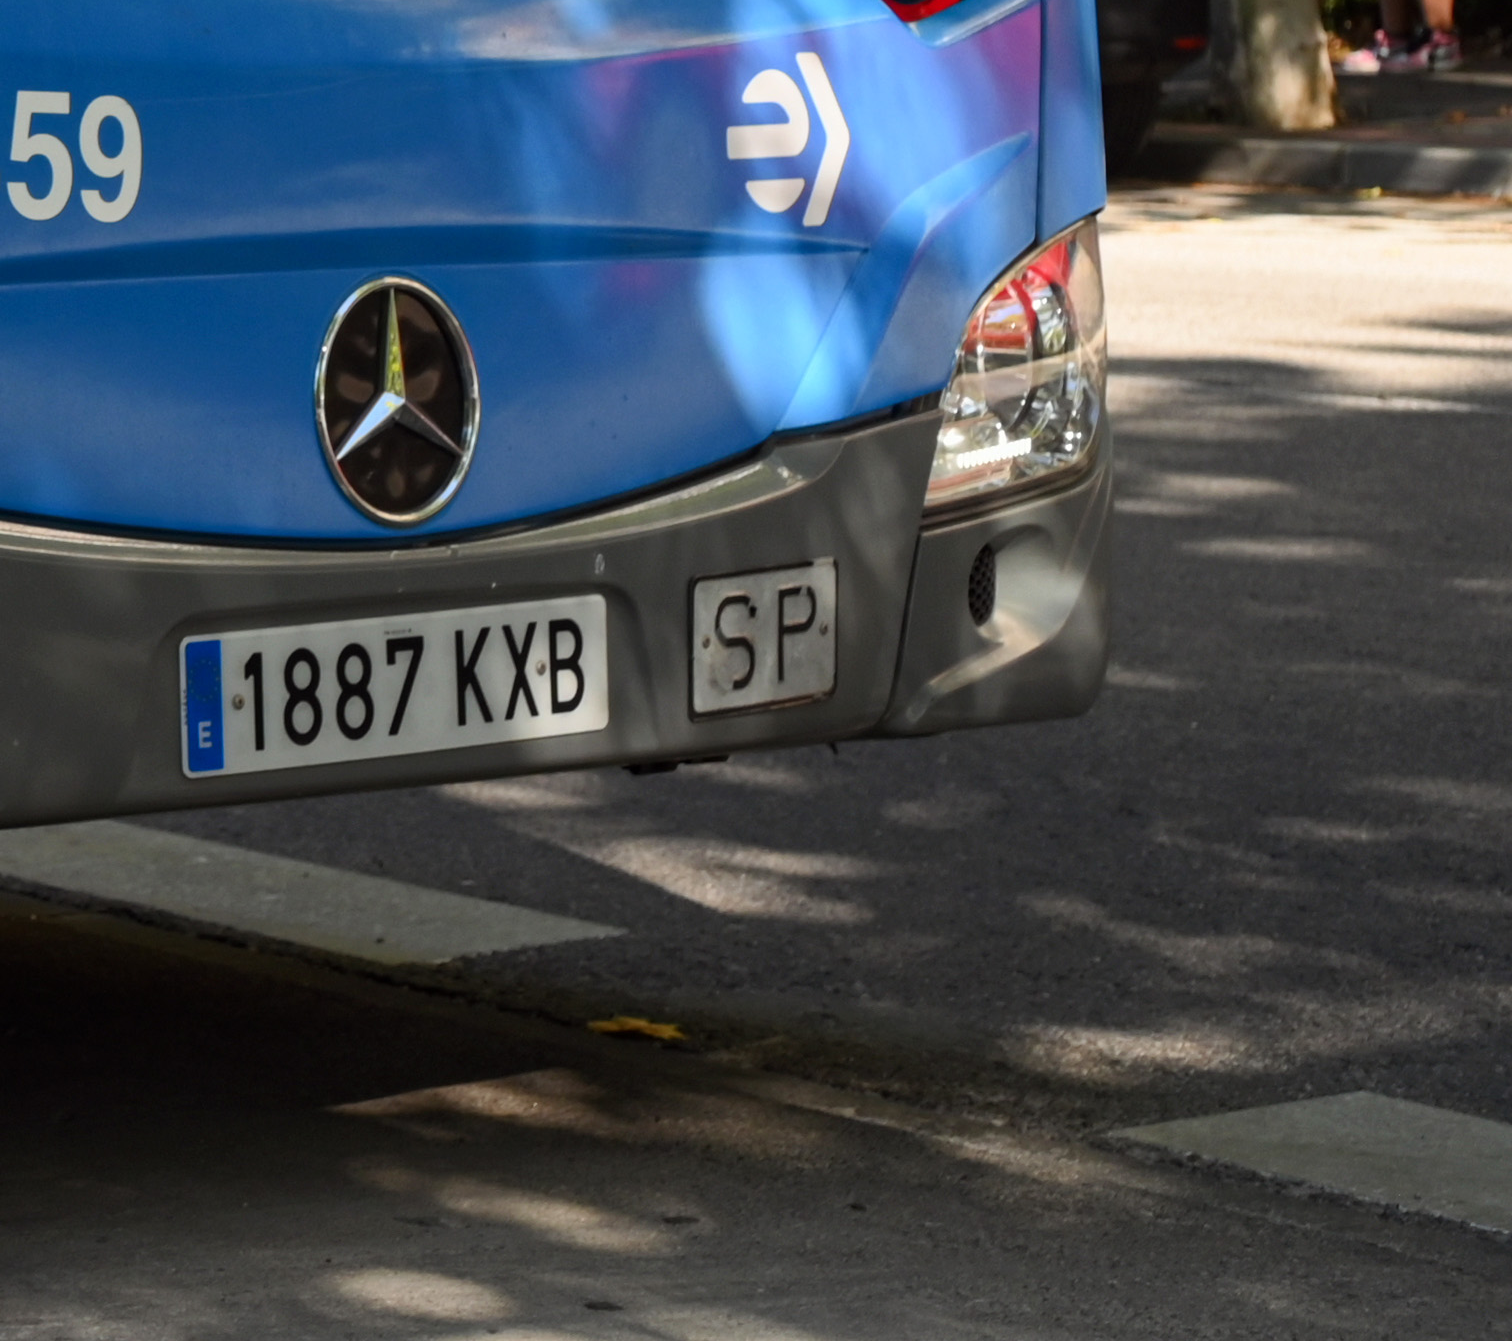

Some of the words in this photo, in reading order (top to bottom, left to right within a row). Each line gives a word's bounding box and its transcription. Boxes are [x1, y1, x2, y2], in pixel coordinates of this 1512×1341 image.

[244, 635, 424, 752] 1887
[454, 618, 585, 727] KXB
[712, 585, 817, 691] SP
[198, 720, 212, 749] E
